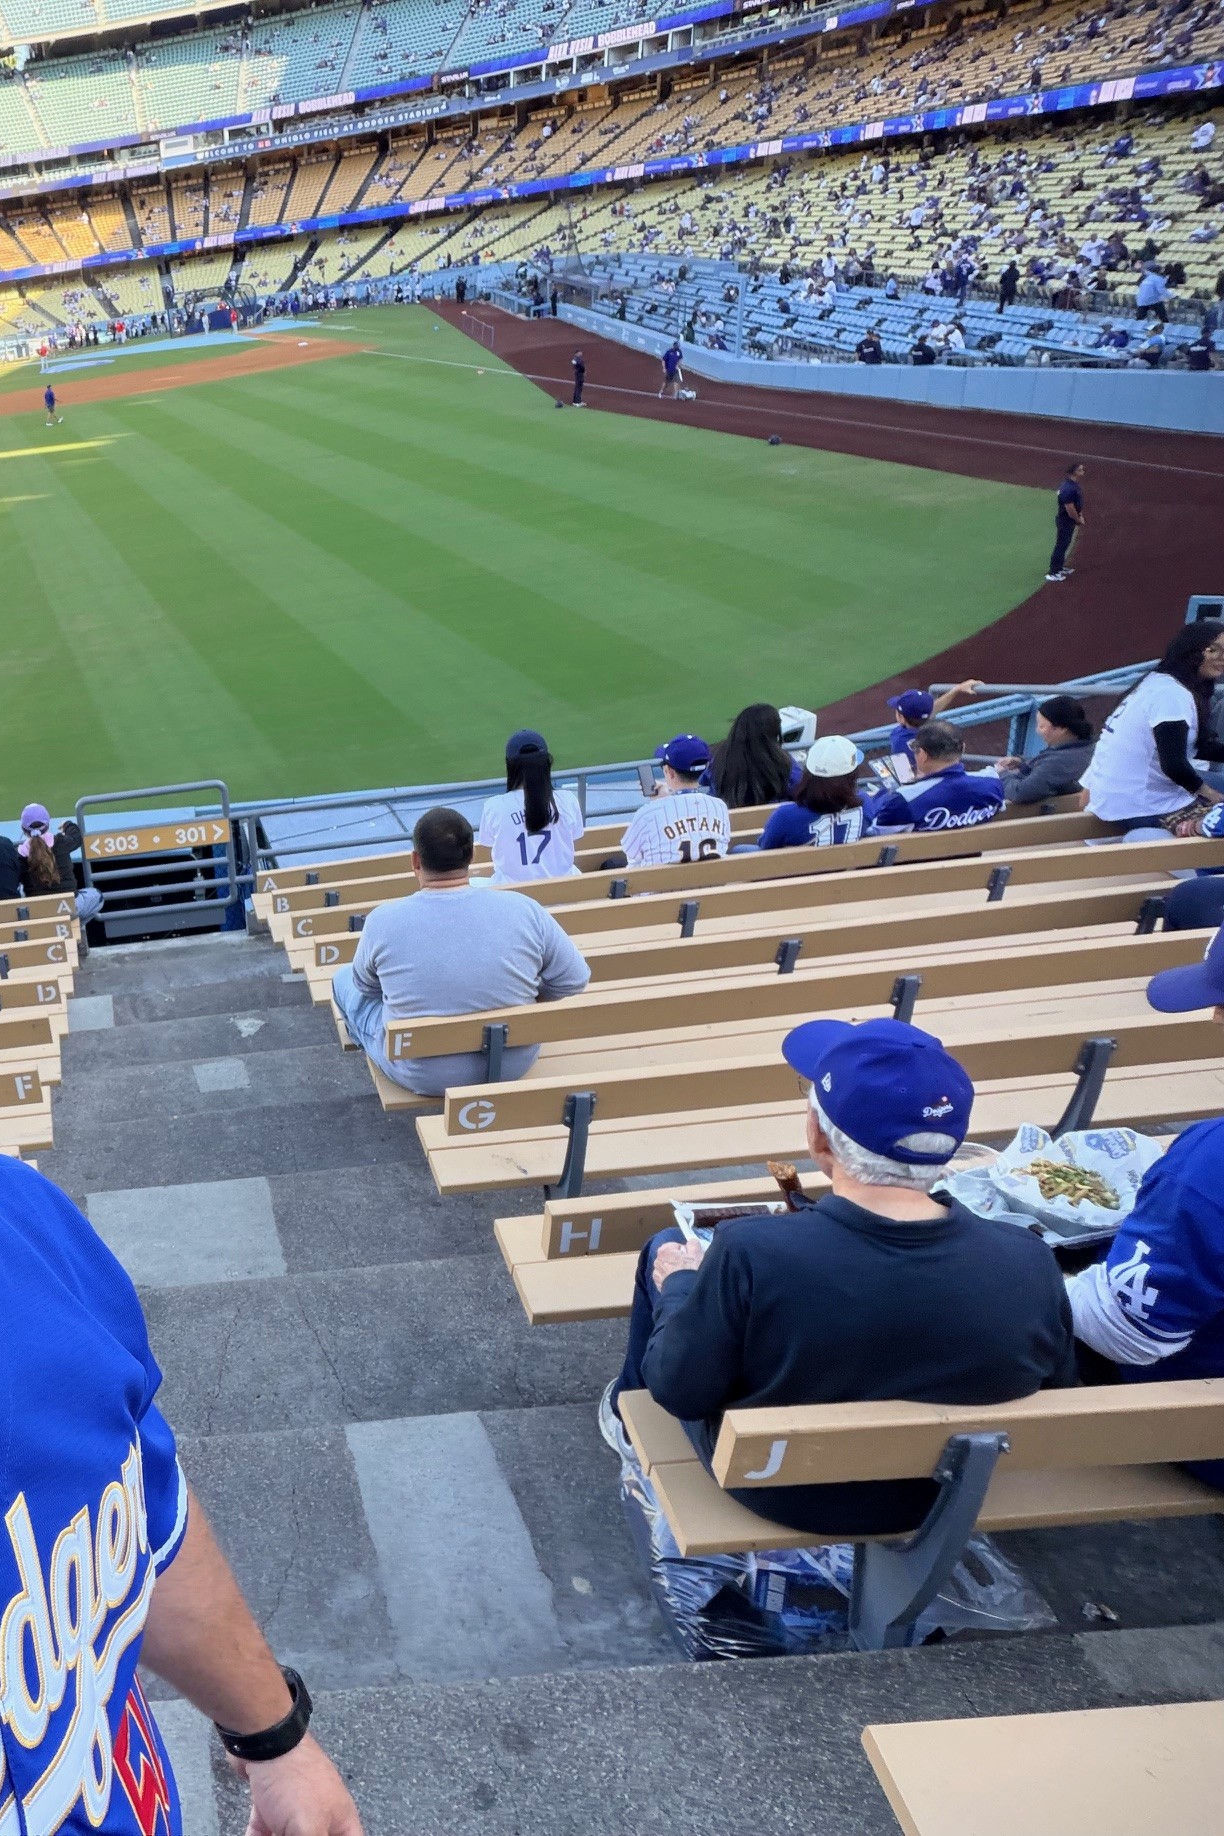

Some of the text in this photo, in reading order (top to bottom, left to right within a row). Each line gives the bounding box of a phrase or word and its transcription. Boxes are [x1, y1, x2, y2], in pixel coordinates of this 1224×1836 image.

[598, 21, 655, 47] BOBBLEHEAD
[299, 92, 355, 113] BOBBLEHEAD
[196, 146, 239, 160] WELCOME
[243, 143, 254, 151] TO
[314, 127, 339, 138] FIELD
[343, 124, 353, 132] AT
[358, 116, 394, 129] DODGER
[399, 107, 439, 120] STADIUM
[663, 817, 726, 840] OHTANI
[809, 806, 863, 847] 17
[104, 826, 207, 853] 303 301
[516, 830, 551, 866] 17
[262, 877, 277, 892] A
[57, 900, 72, 914] A
[276, 897, 290, 912] B
[55, 924, 70, 938] B
[296, 918, 313, 936] C
[46, 944, 63, 961] C
[320, 945, 339, 963] D
[36, 984, 56, 1002] D
[394, 1032, 412, 1056] F
[14, 1075, 33, 1100] F
[458, 1100, 496, 1129] G
[559, 1217, 602, 1254] H
[1107, 1240, 1159, 1320] LA
[744, 1440, 788, 1480] J
